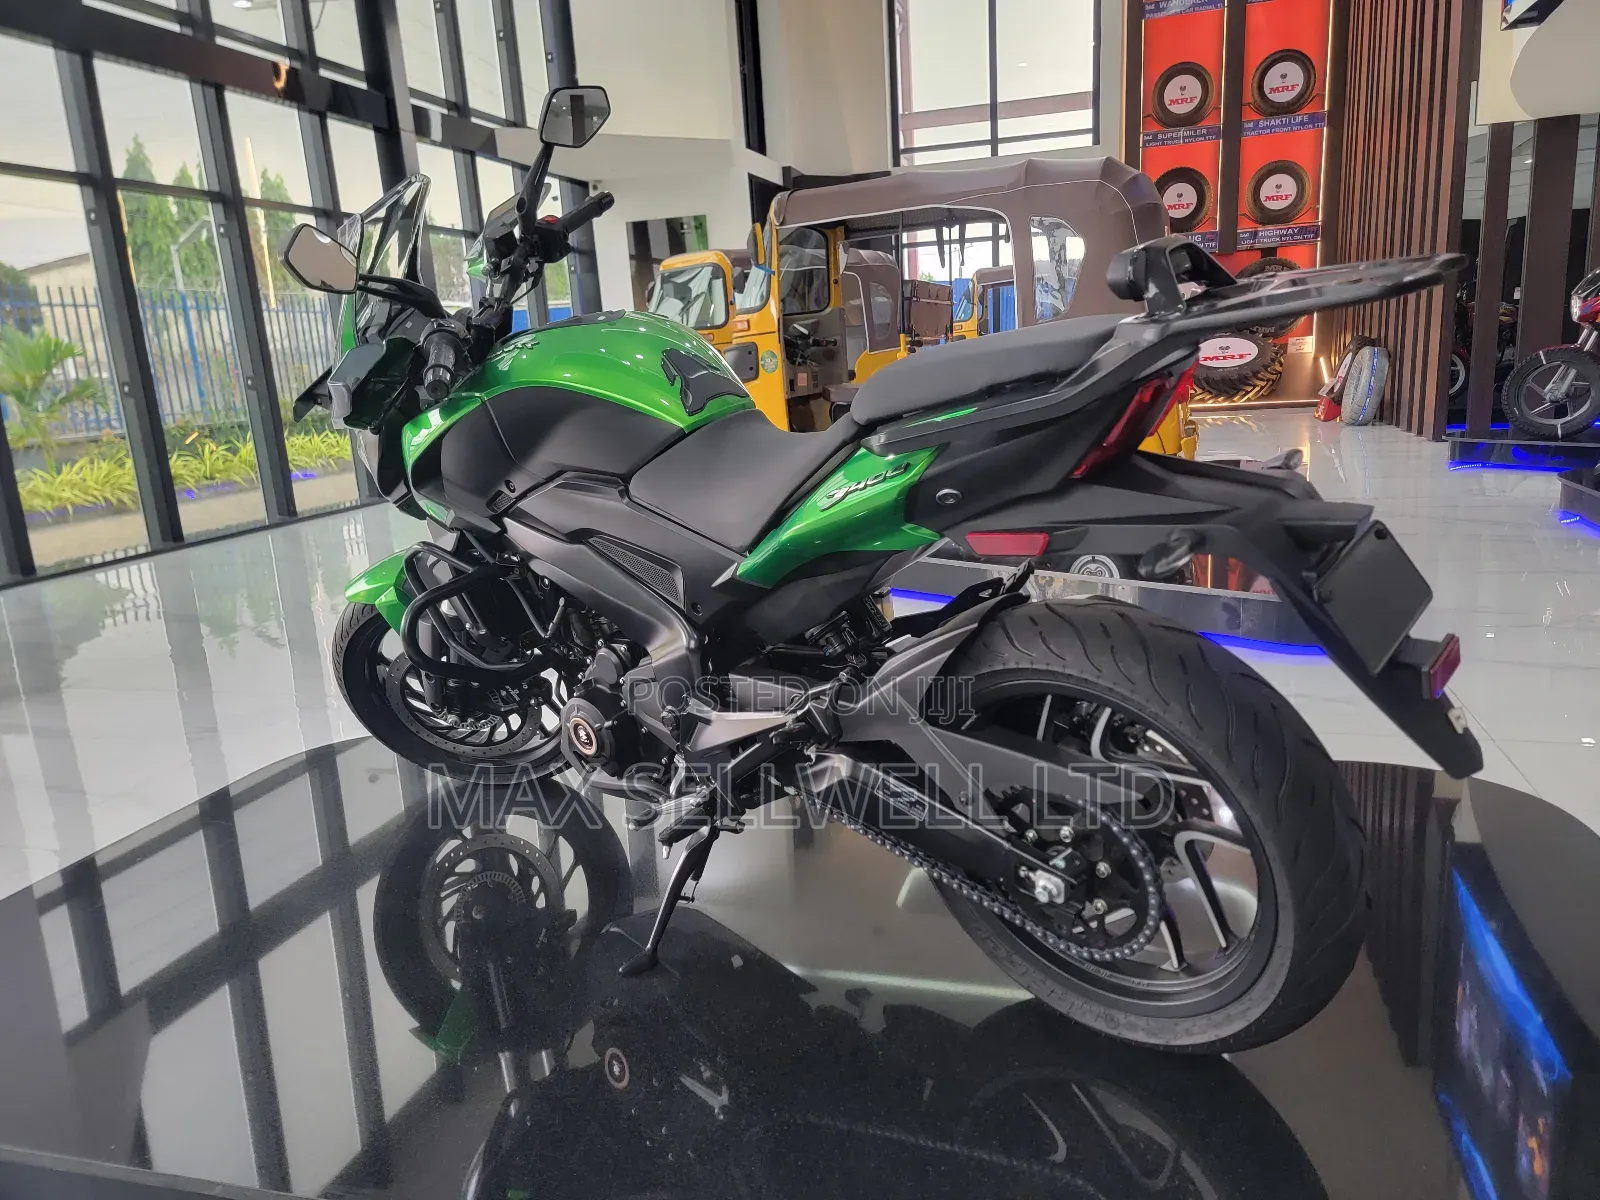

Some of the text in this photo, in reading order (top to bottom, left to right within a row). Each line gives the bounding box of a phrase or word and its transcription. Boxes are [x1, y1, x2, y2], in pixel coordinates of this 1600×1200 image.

[1268, 84, 1300, 95] MRF
[1168, 96, 1198, 107] MRF
[1258, 117, 1289, 128] SHAKTI
[1291, 115, 1309, 124] LIFE
[1157, 128, 1207, 140] SUPERMILER
[1263, 193, 1293, 202] MRF
[1167, 203, 1193, 211] MRF
[1258, 227, 1300, 237] HIGHWAY
[1201, 353, 1252, 362] MRF
